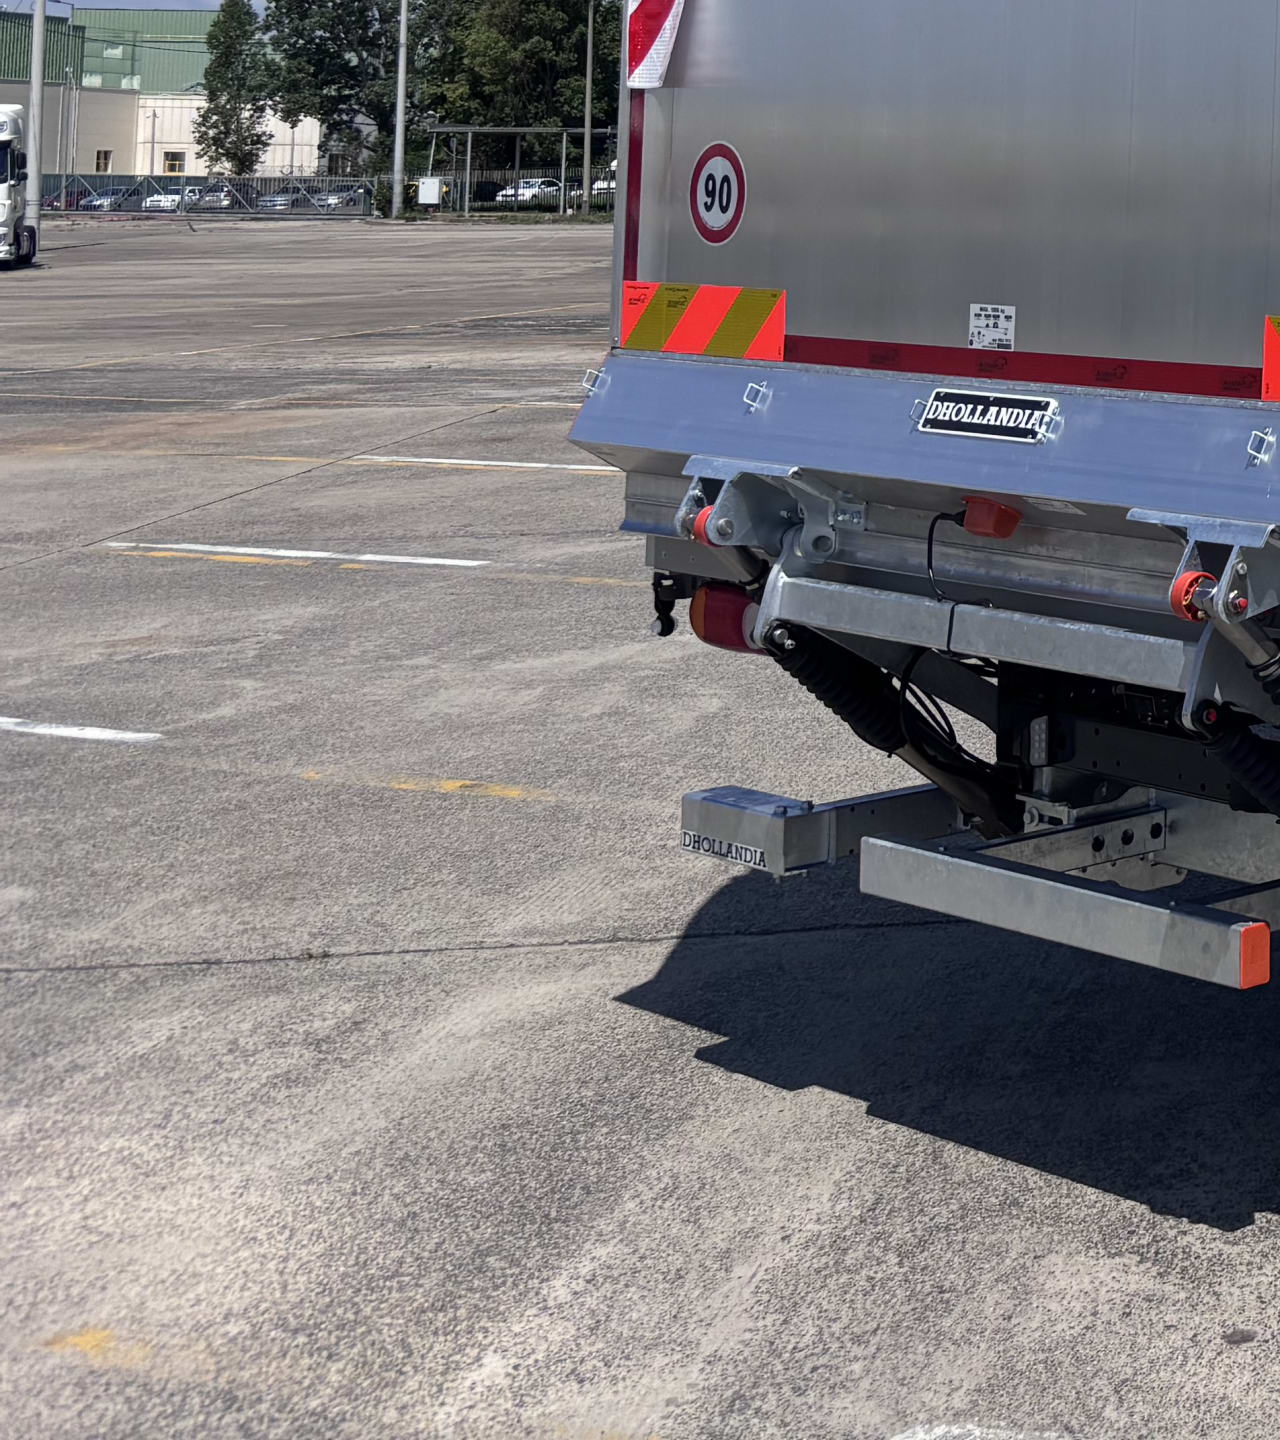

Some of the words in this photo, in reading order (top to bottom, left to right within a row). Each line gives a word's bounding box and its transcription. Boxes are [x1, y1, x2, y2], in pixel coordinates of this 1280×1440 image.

[703, 173, 732, 215] 90
[926, 401, 1044, 430] DHOLLANDIA
[682, 831, 767, 868] DHOLLANDIA
